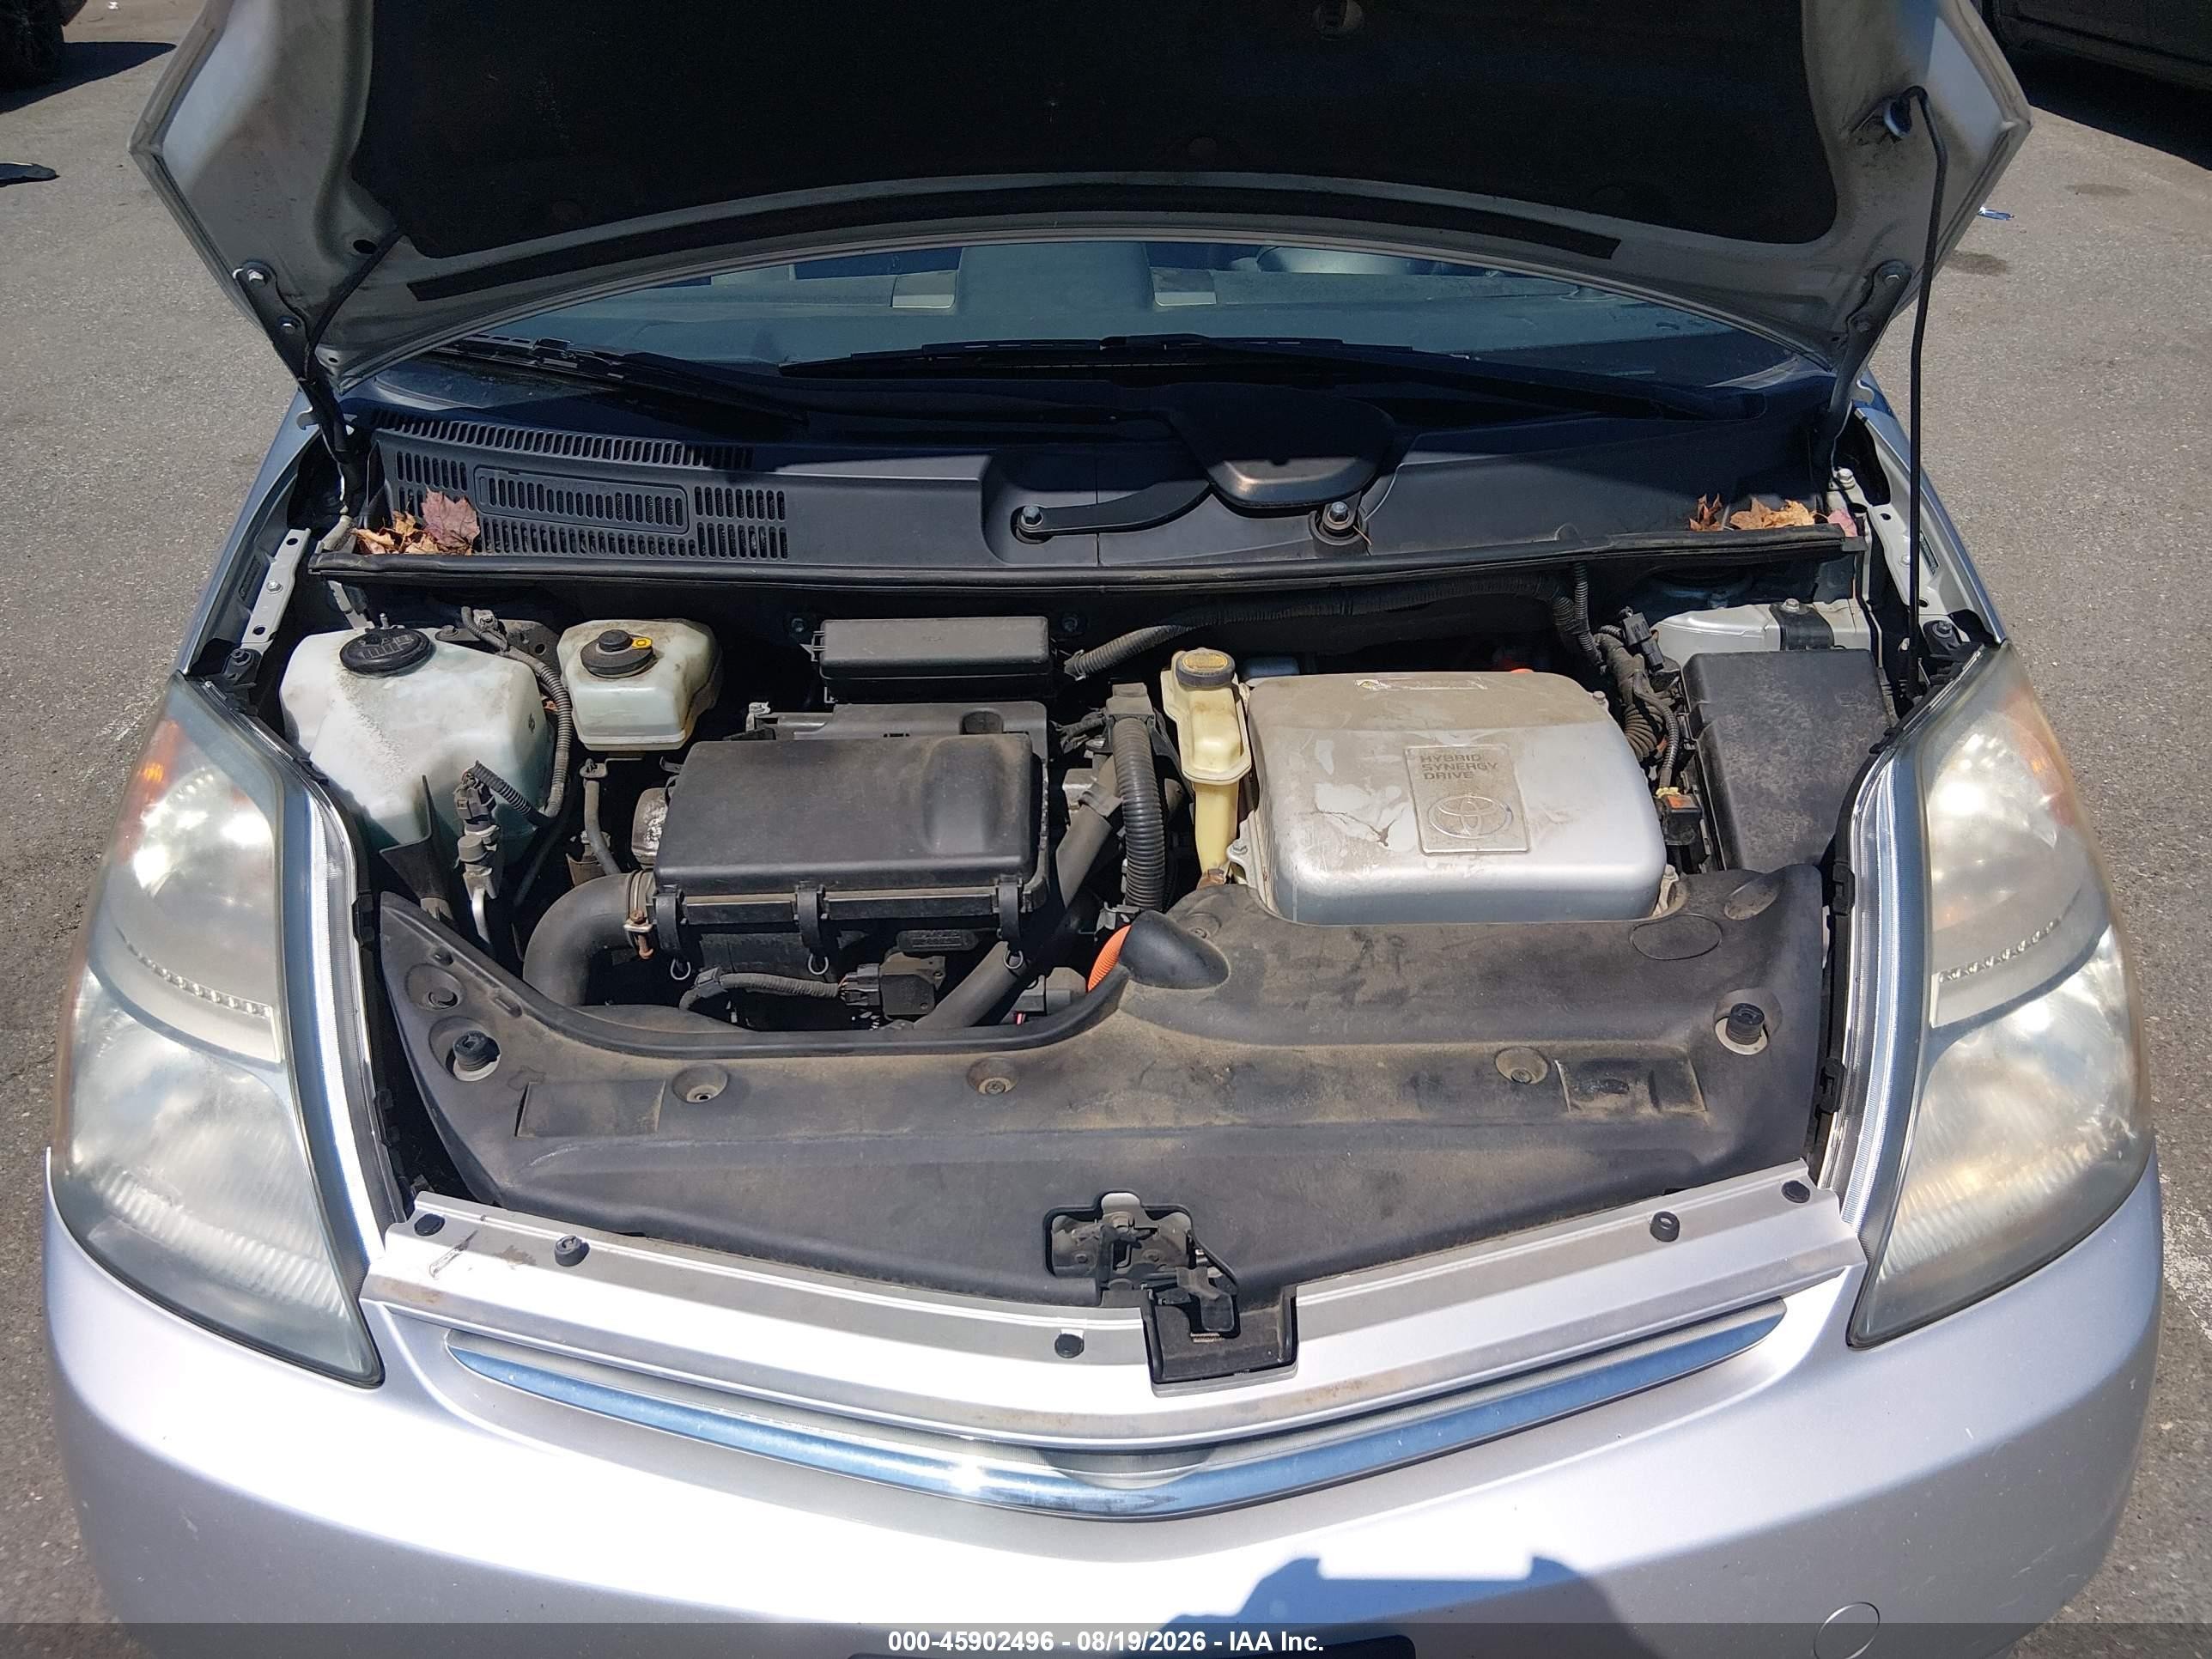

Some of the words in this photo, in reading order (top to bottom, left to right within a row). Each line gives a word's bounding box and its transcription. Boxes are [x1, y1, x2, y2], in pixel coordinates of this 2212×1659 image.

[1420, 754, 1482, 763] HYBRID
[1422, 762, 1498, 771] SYNERGY
[1424, 771, 1474, 780] DRIVE
